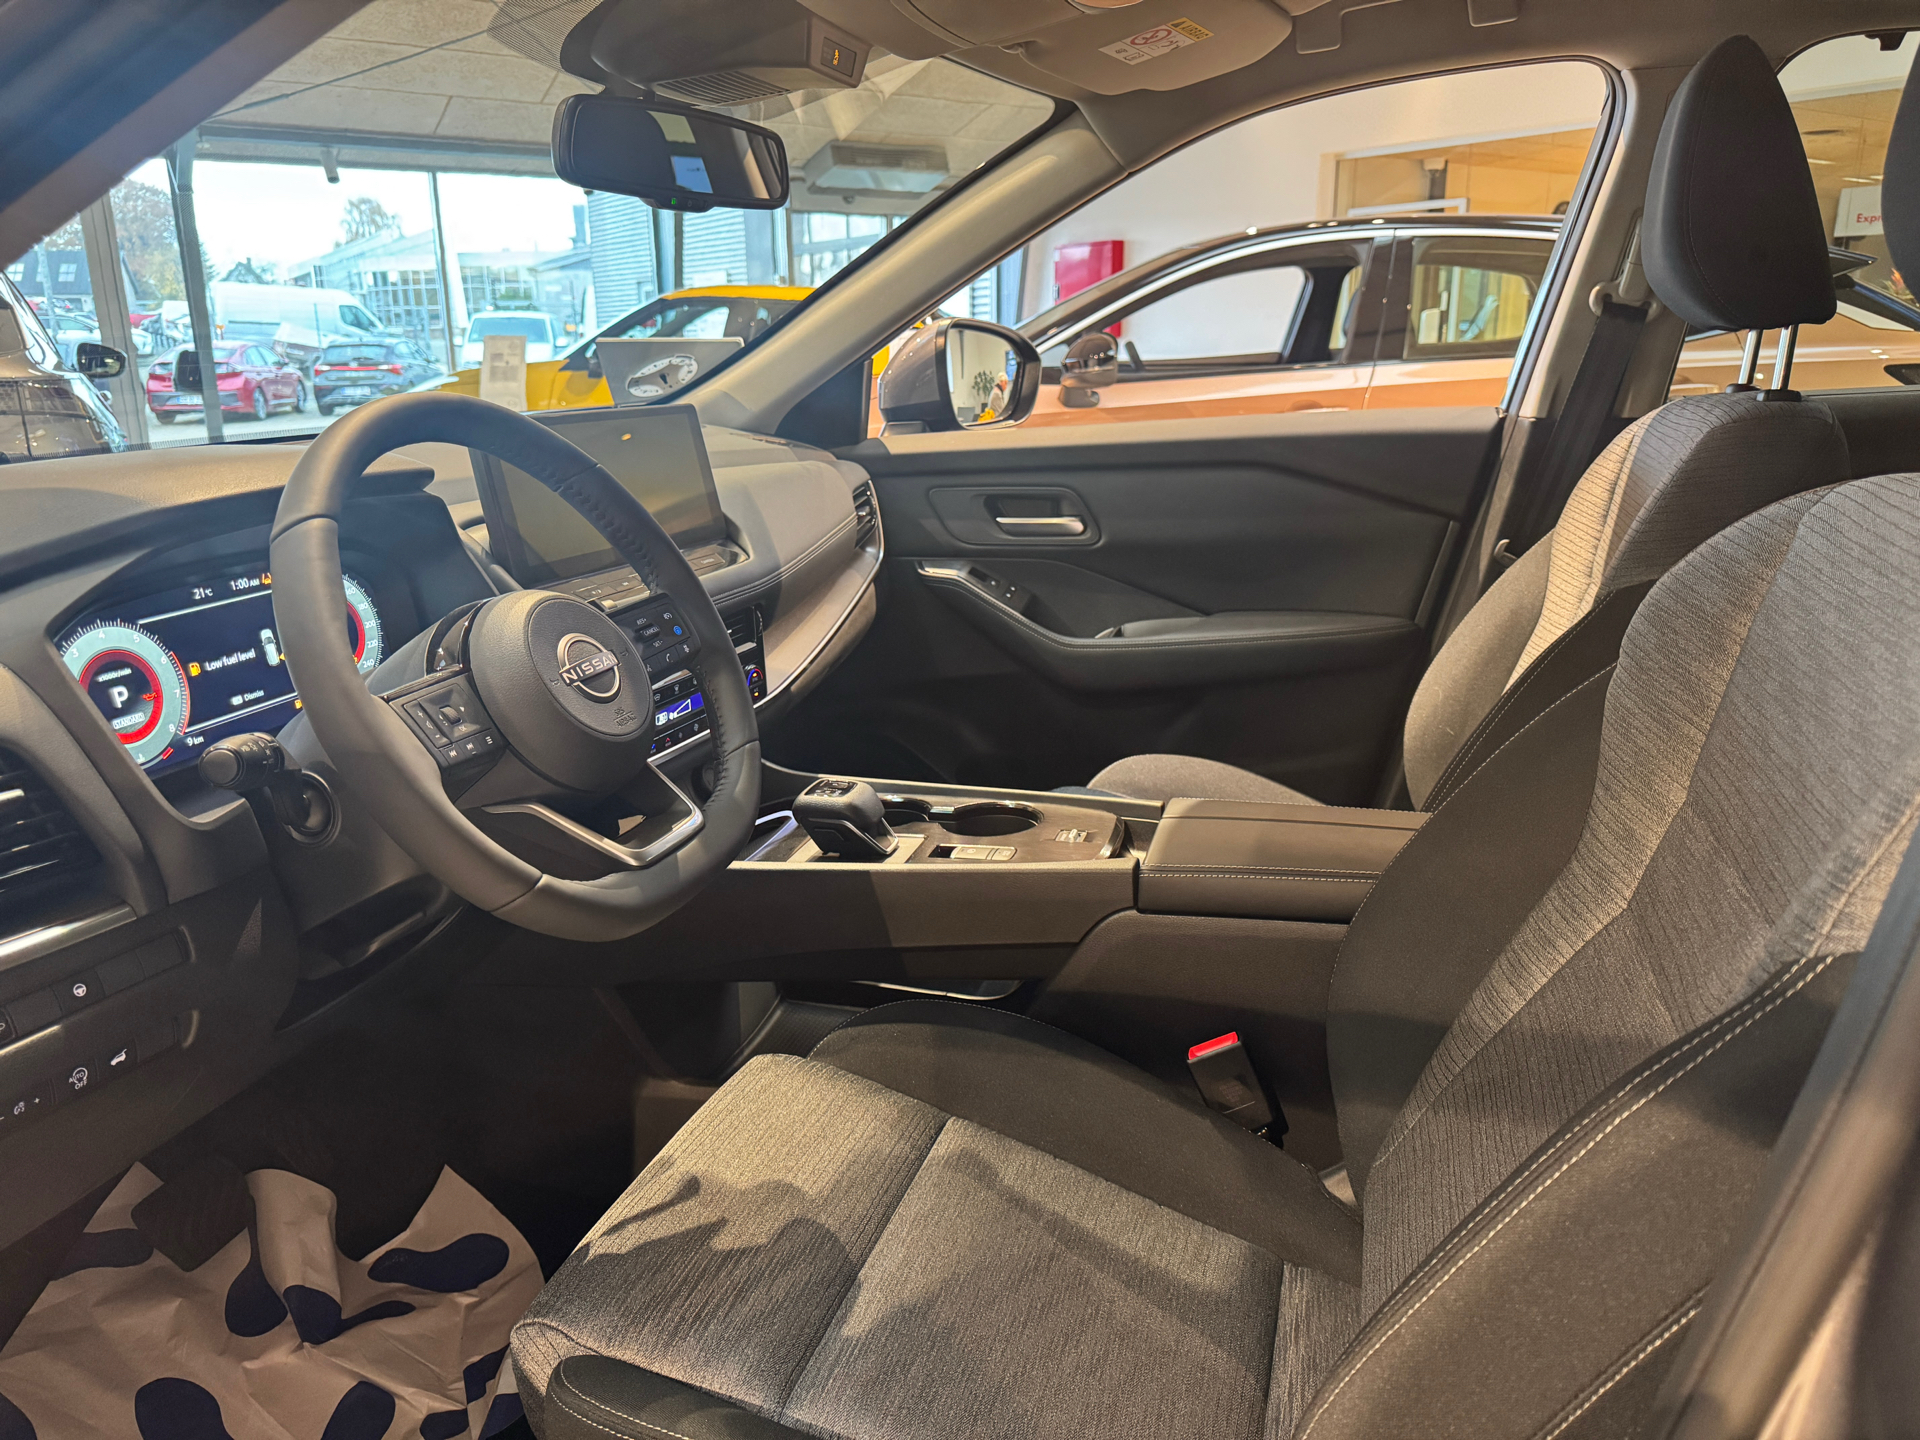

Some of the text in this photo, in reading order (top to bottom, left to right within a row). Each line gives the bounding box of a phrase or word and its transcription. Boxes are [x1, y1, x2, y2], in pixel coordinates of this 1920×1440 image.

[357, 602, 368, 611] 180
[365, 619, 376, 629] 200
[98, 630, 105, 640] 4
[133, 634, 140, 643] 5
[366, 639, 378, 649] 220
[71, 648, 79, 658] 3
[160, 656, 167, 665] 6
[205, 647, 256, 671] Low fuel level
[362, 658, 375, 669] 240
[561, 653, 619, 684] NISSAN
[112, 685, 129, 708] P
[174, 689, 180, 698] 7
[243, 689, 265, 702] Dismiss
[113, 713, 145, 729] STANDARD
[168, 723, 175, 733] 8
[193, 736, 204, 745] km
[69, 1071, 84, 1083] AUTO
[75, 1079, 88, 1090] OFF
